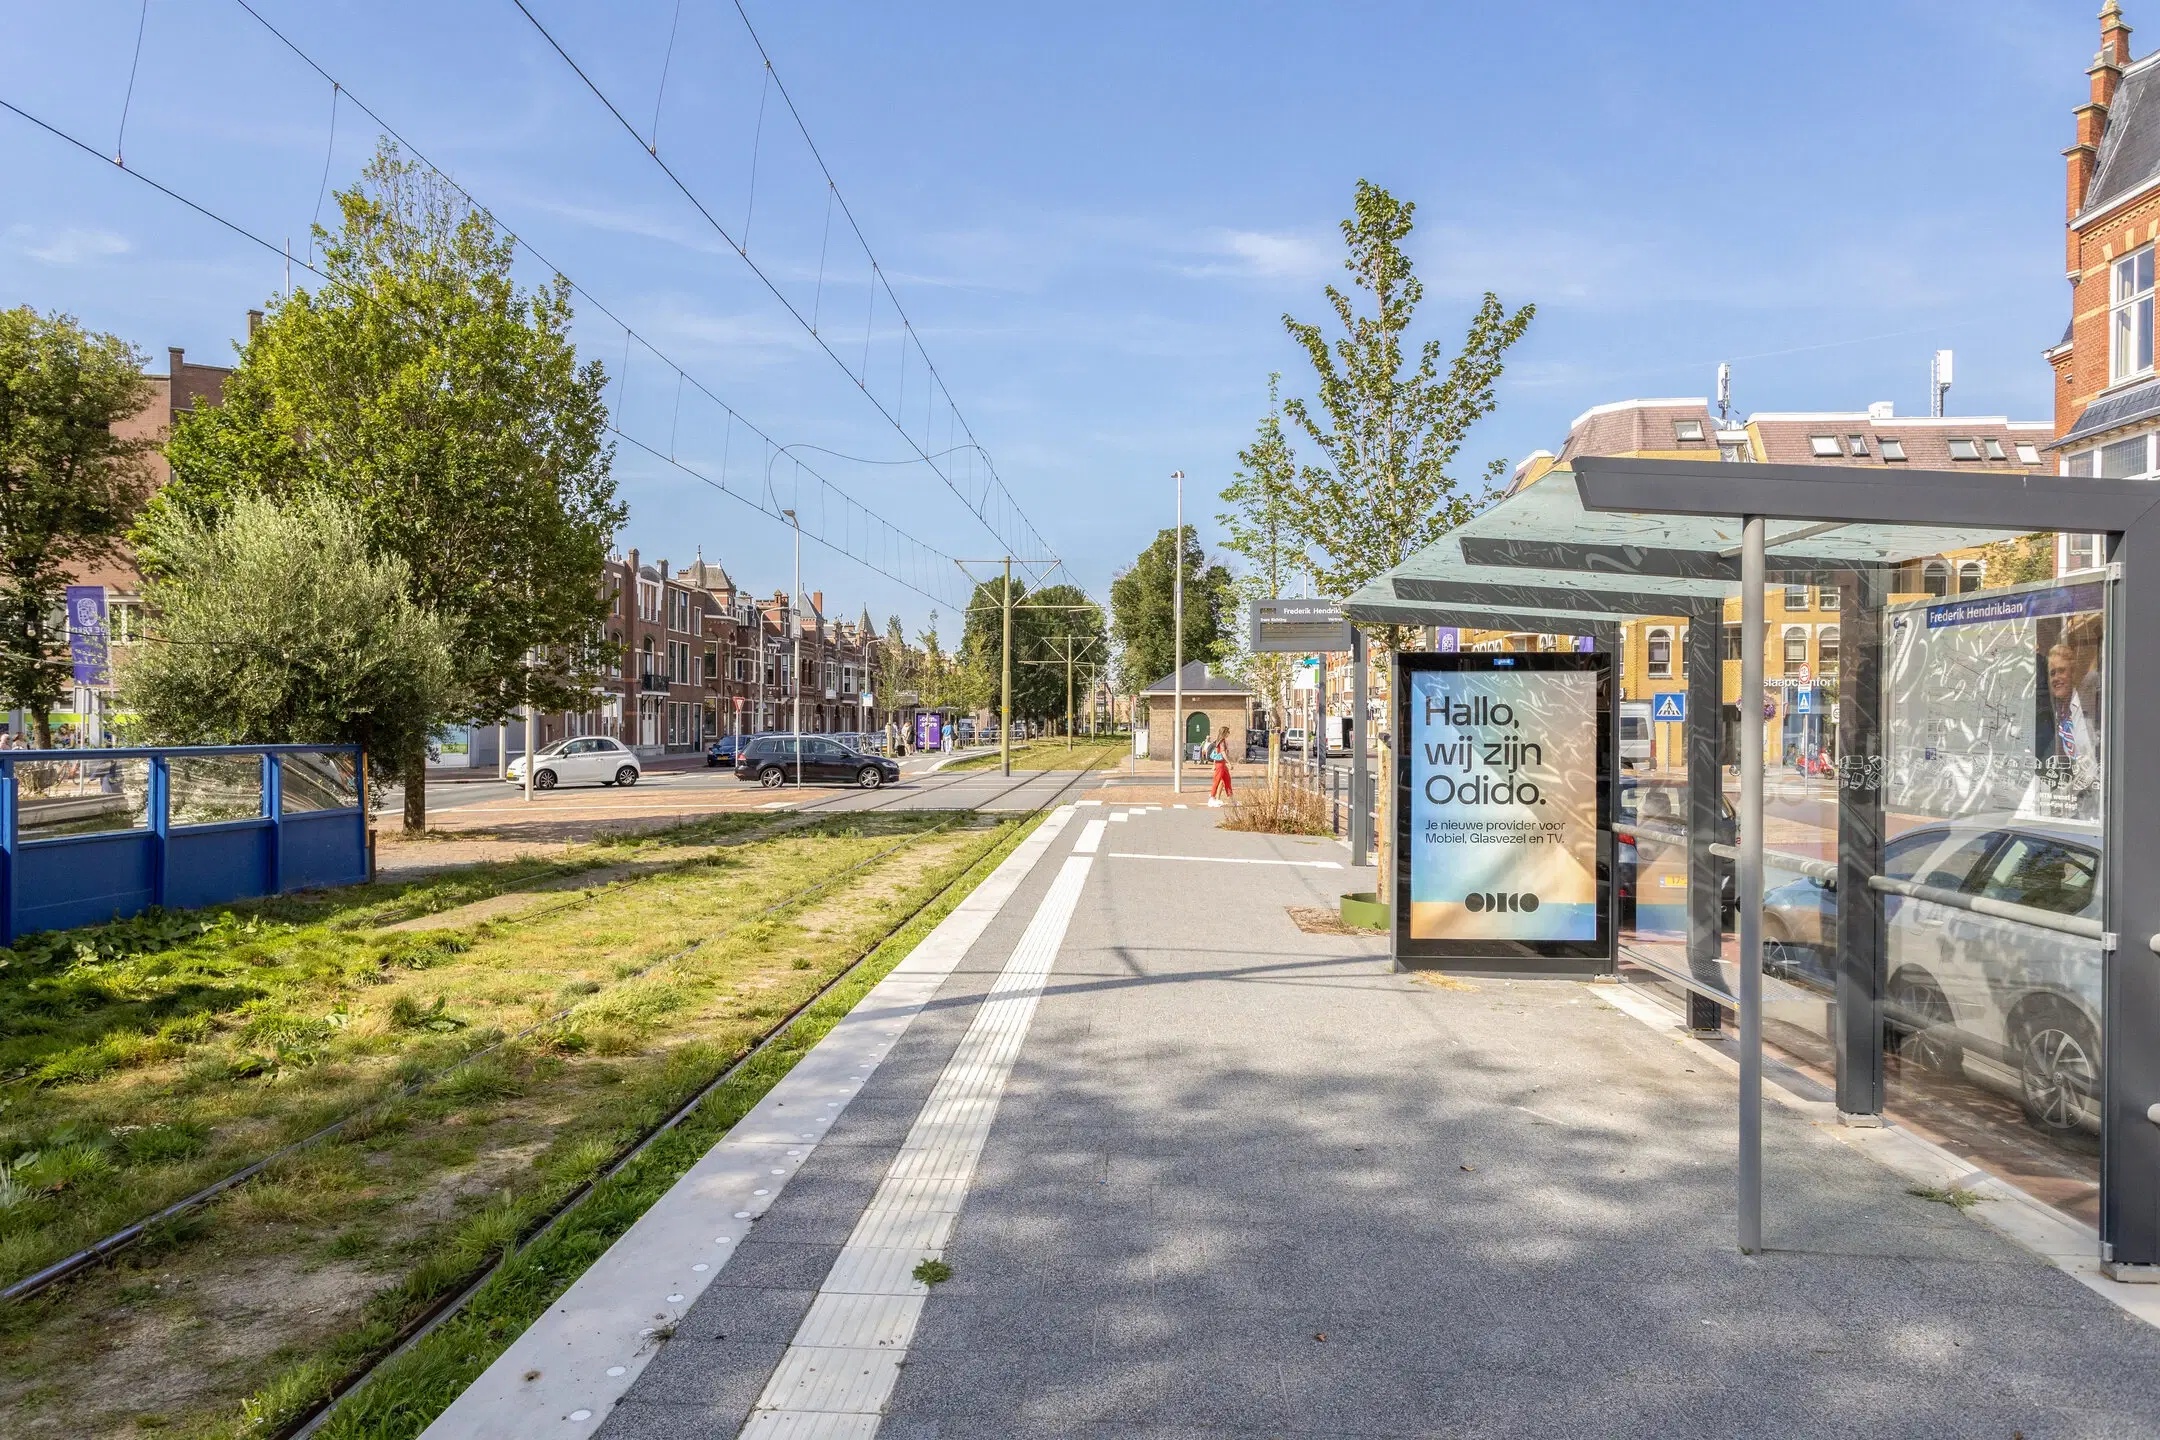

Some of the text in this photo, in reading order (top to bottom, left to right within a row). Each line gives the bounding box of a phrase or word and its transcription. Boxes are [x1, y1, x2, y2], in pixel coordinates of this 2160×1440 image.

[1283, 607, 1311, 615] Frederik
[1930, 602, 2023, 623] Frederik Hendriklaan
[1425, 695, 1519, 729] Hallo,
[1424, 735, 1541, 773] wij zijn
[1425, 775, 1547, 805] Odido.
[1425, 820, 1566, 832] Je nieuwe provider voor
[1425, 833, 1565, 844] Mobiel, Glasvezel en TV.
